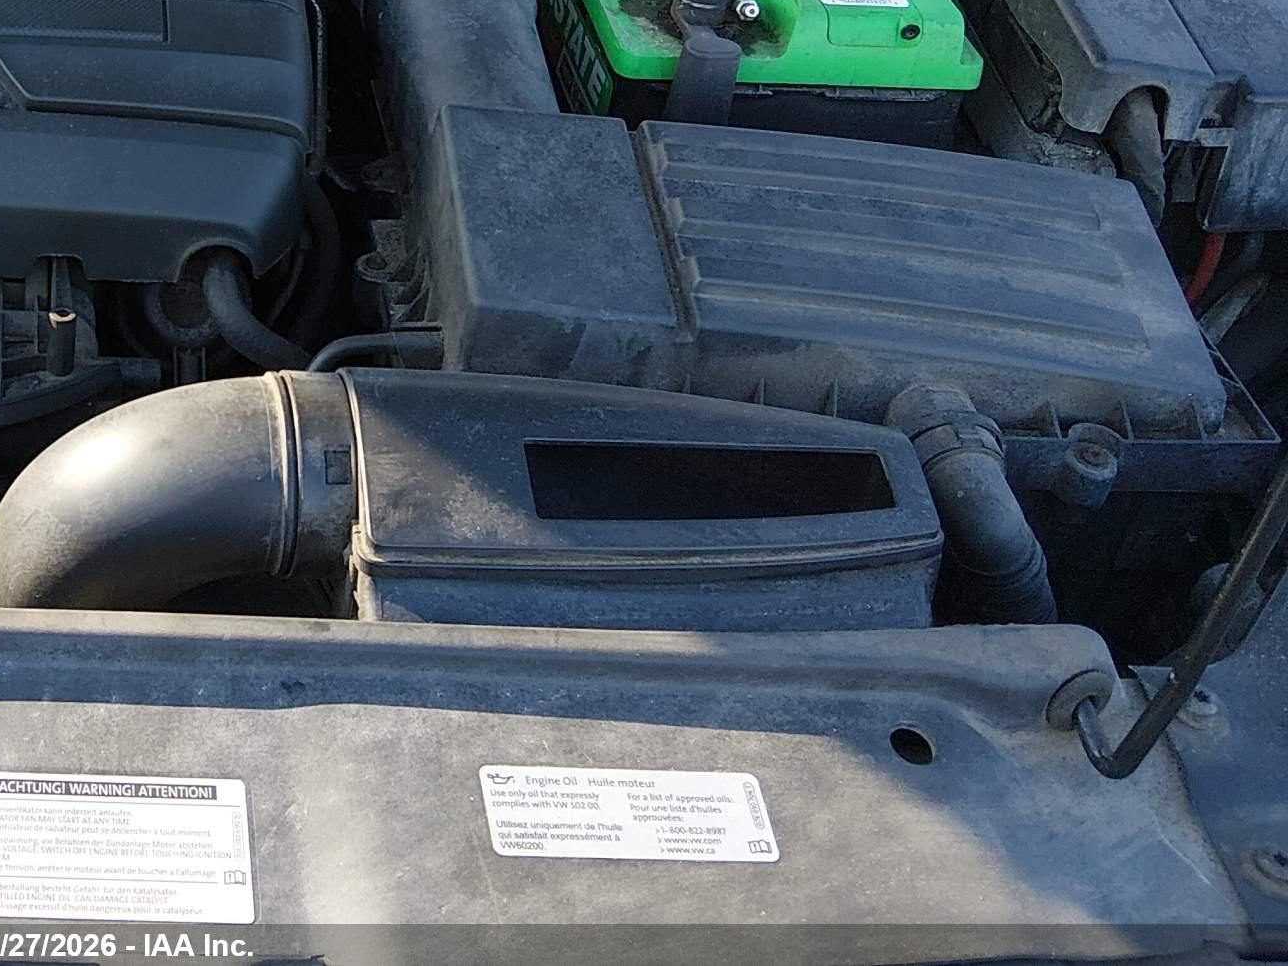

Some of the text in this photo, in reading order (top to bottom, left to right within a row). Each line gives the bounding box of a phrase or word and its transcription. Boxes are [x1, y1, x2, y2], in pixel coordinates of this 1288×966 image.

[526, 776, 655, 788] Engine Oil Huile moteur
[70, 783, 135, 796] WARNING!
[138, 786, 212, 798] ATTENTION!
[509, 789, 525, 800] only
[560, 792, 600, 801] expressly
[627, 793, 641, 801] For
[649, 793, 663, 801] list
[665, 793, 674, 801] of
[675, 794, 714, 803] approved
[492, 800, 530, 808] complies
[630, 804, 649, 812] Pour
[670, 804, 688, 813] liste
[496, 820, 528, 829] Utilisez
[530, 822, 582, 832] uniquement
[584, 823, 595, 831] de
[499, 831, 511, 840] qui
[514, 832, 548, 840] satisfait
